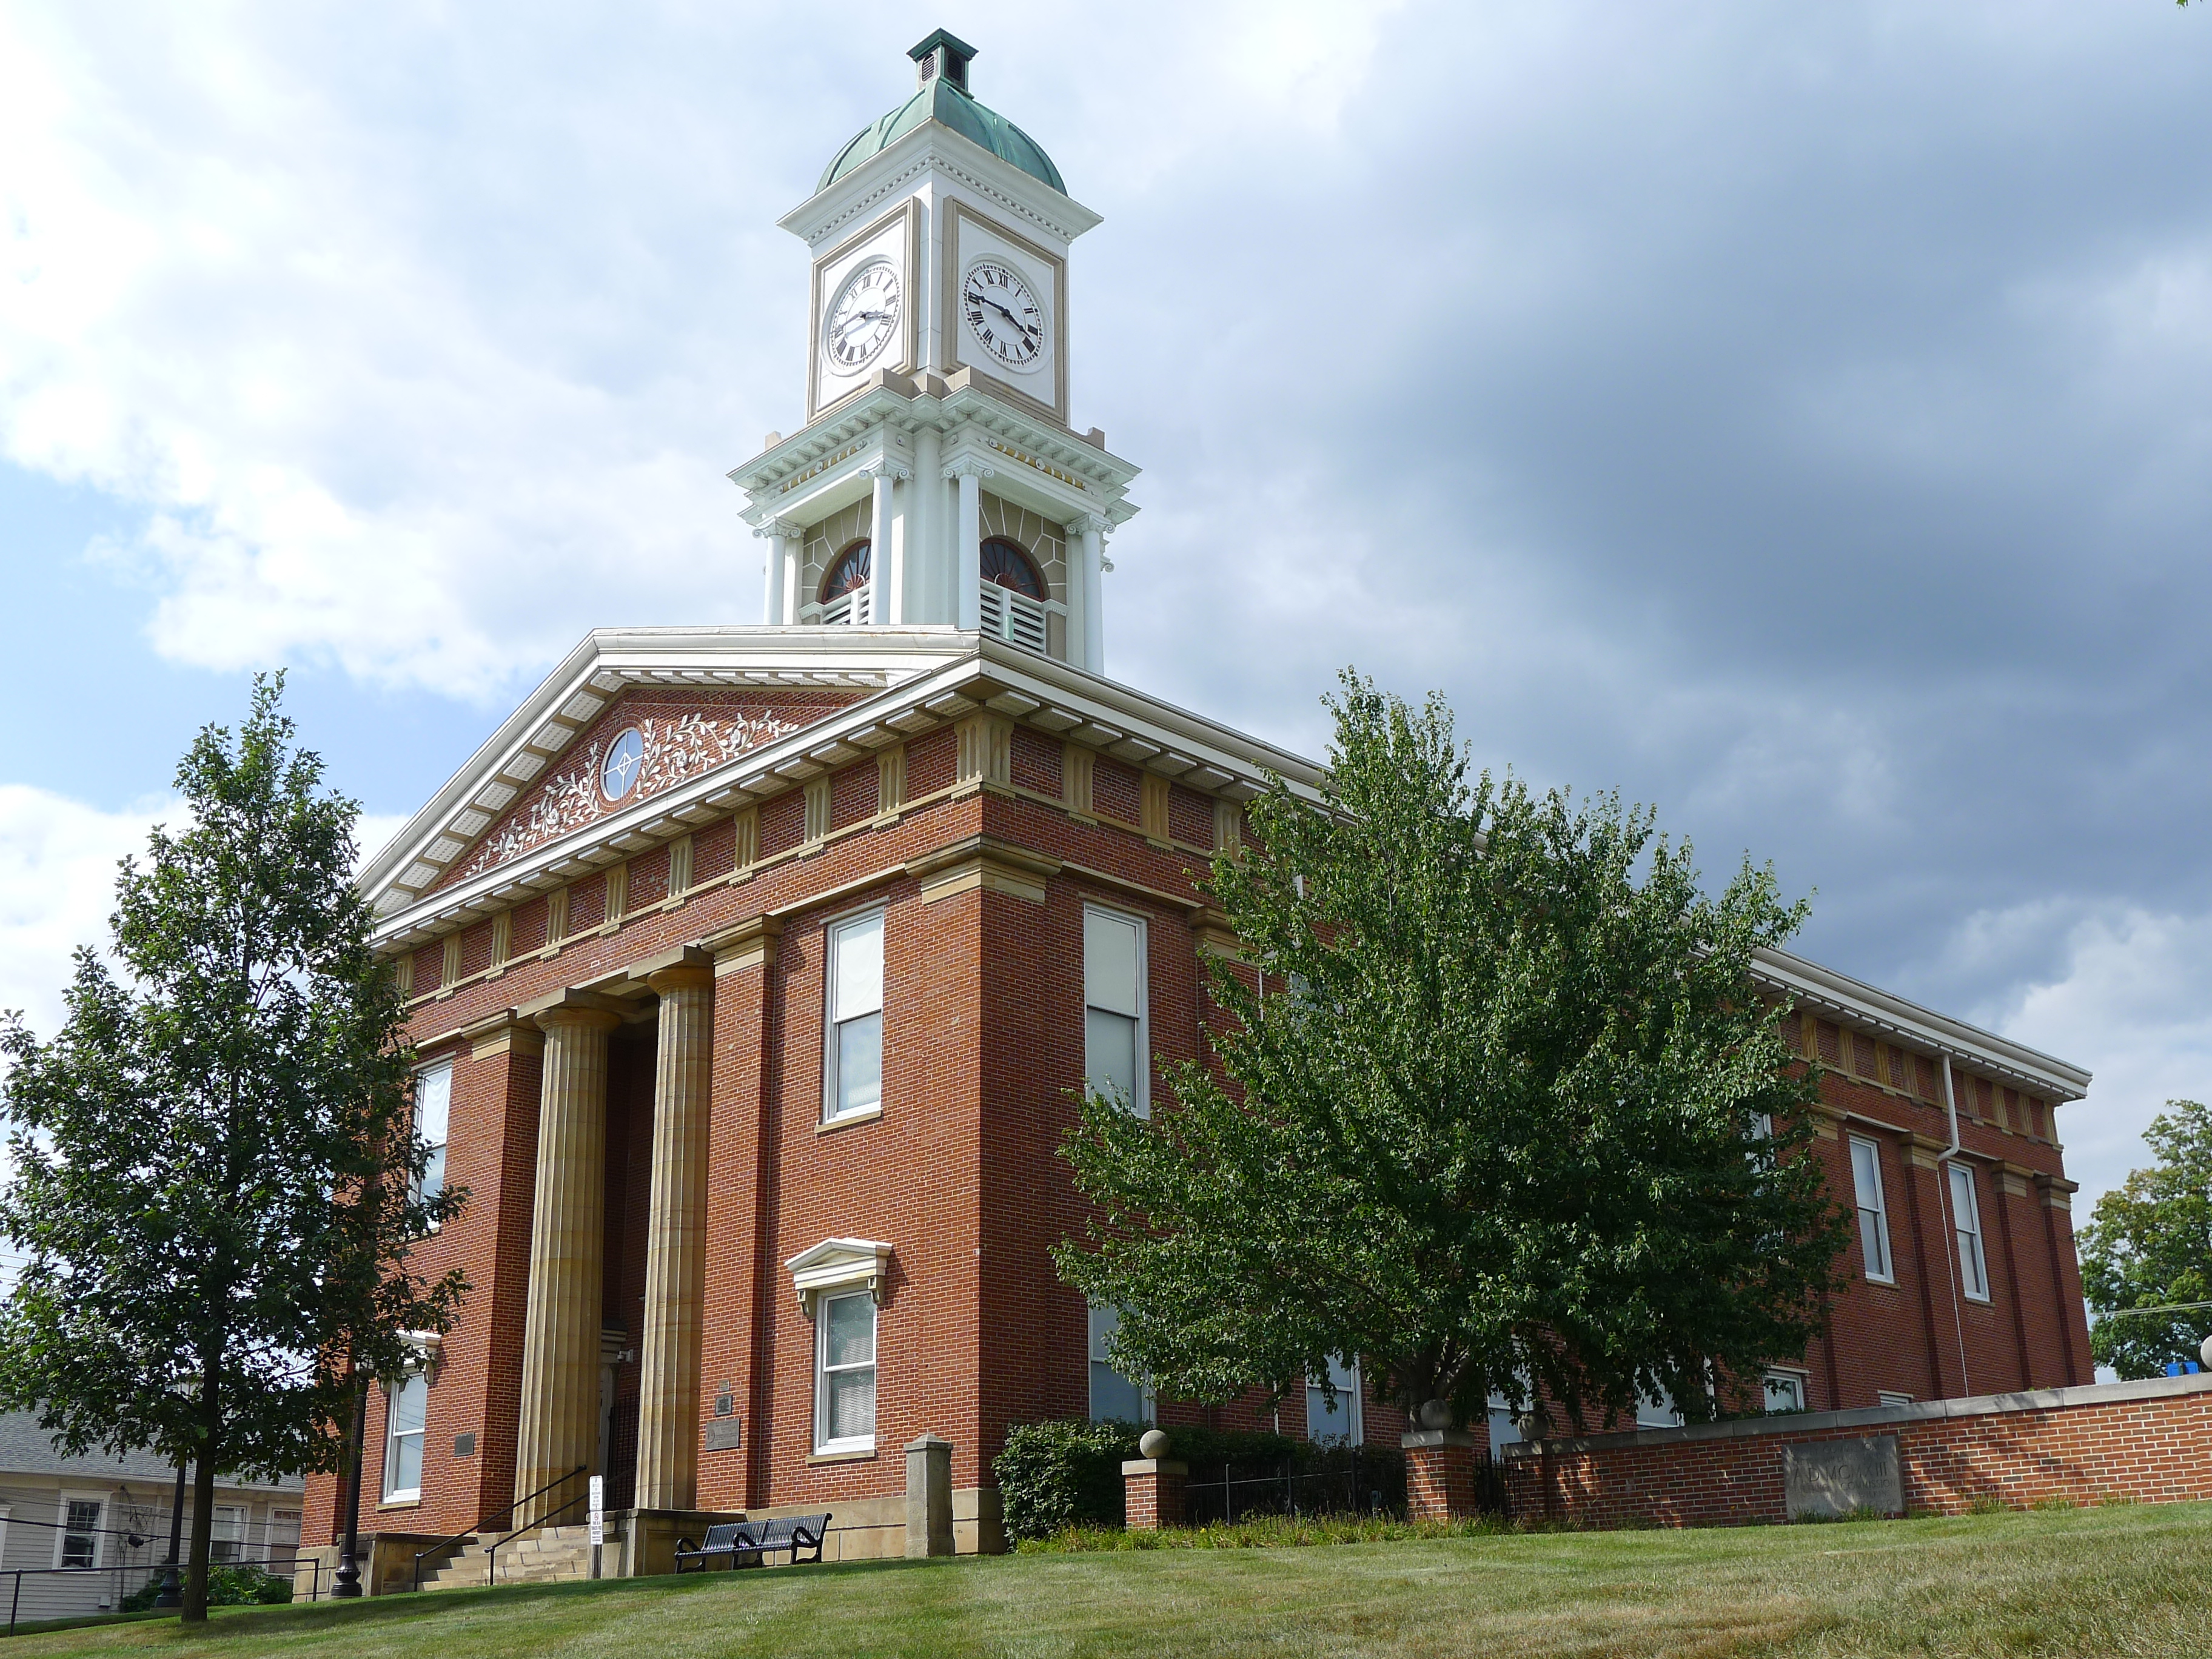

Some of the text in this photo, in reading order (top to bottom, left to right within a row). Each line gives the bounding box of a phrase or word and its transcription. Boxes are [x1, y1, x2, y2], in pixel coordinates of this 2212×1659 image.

[862, 274, 871, 290] XII
[972, 276, 984, 291] X
[982, 270, 994, 284] XI
[999, 273, 1008, 289] XII
[850, 288, 857, 301] XI
[971, 311, 985, 326] VIII
[982, 329, 994, 344] VII
[860, 343, 866, 358] VI
[1000, 341, 1007, 357] VI
[1015, 344, 1023, 360] V
[1840, 1478, 1895, 1490] COMMISSION
